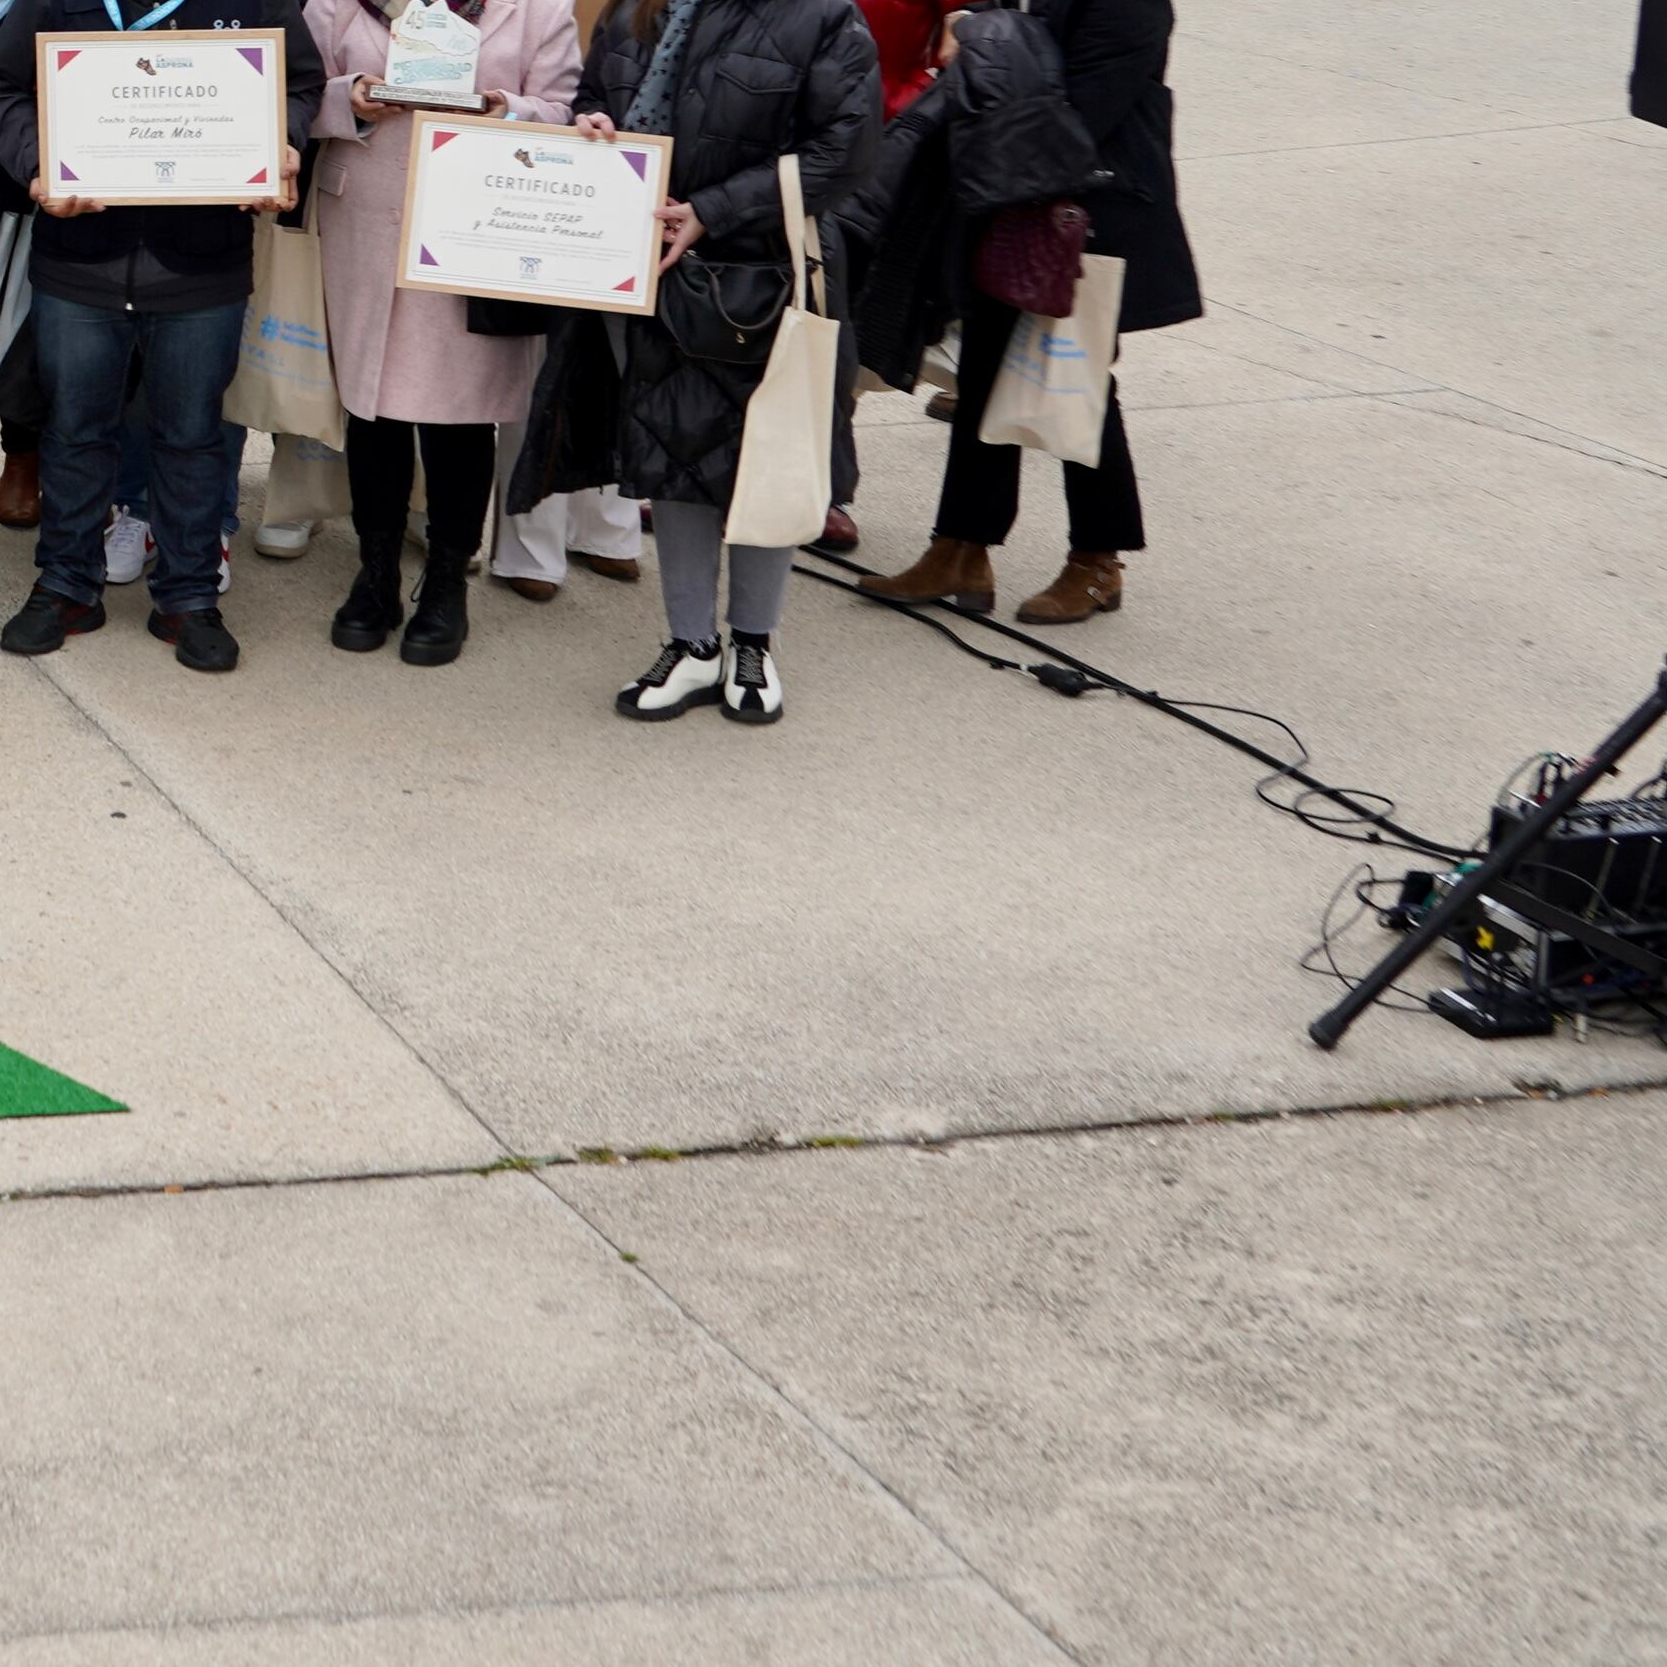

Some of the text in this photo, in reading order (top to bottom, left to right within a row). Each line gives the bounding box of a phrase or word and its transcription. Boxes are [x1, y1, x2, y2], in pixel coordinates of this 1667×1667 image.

[405, 10, 425, 30] 45
[112, 84, 219, 99] CERTIFICADO
[128, 126, 203, 140] Pilar Miró
[484, 174, 596, 198] CERTIFICADO
[491, 206, 539, 221] Servicio
[551, 223, 604, 240] Personal
